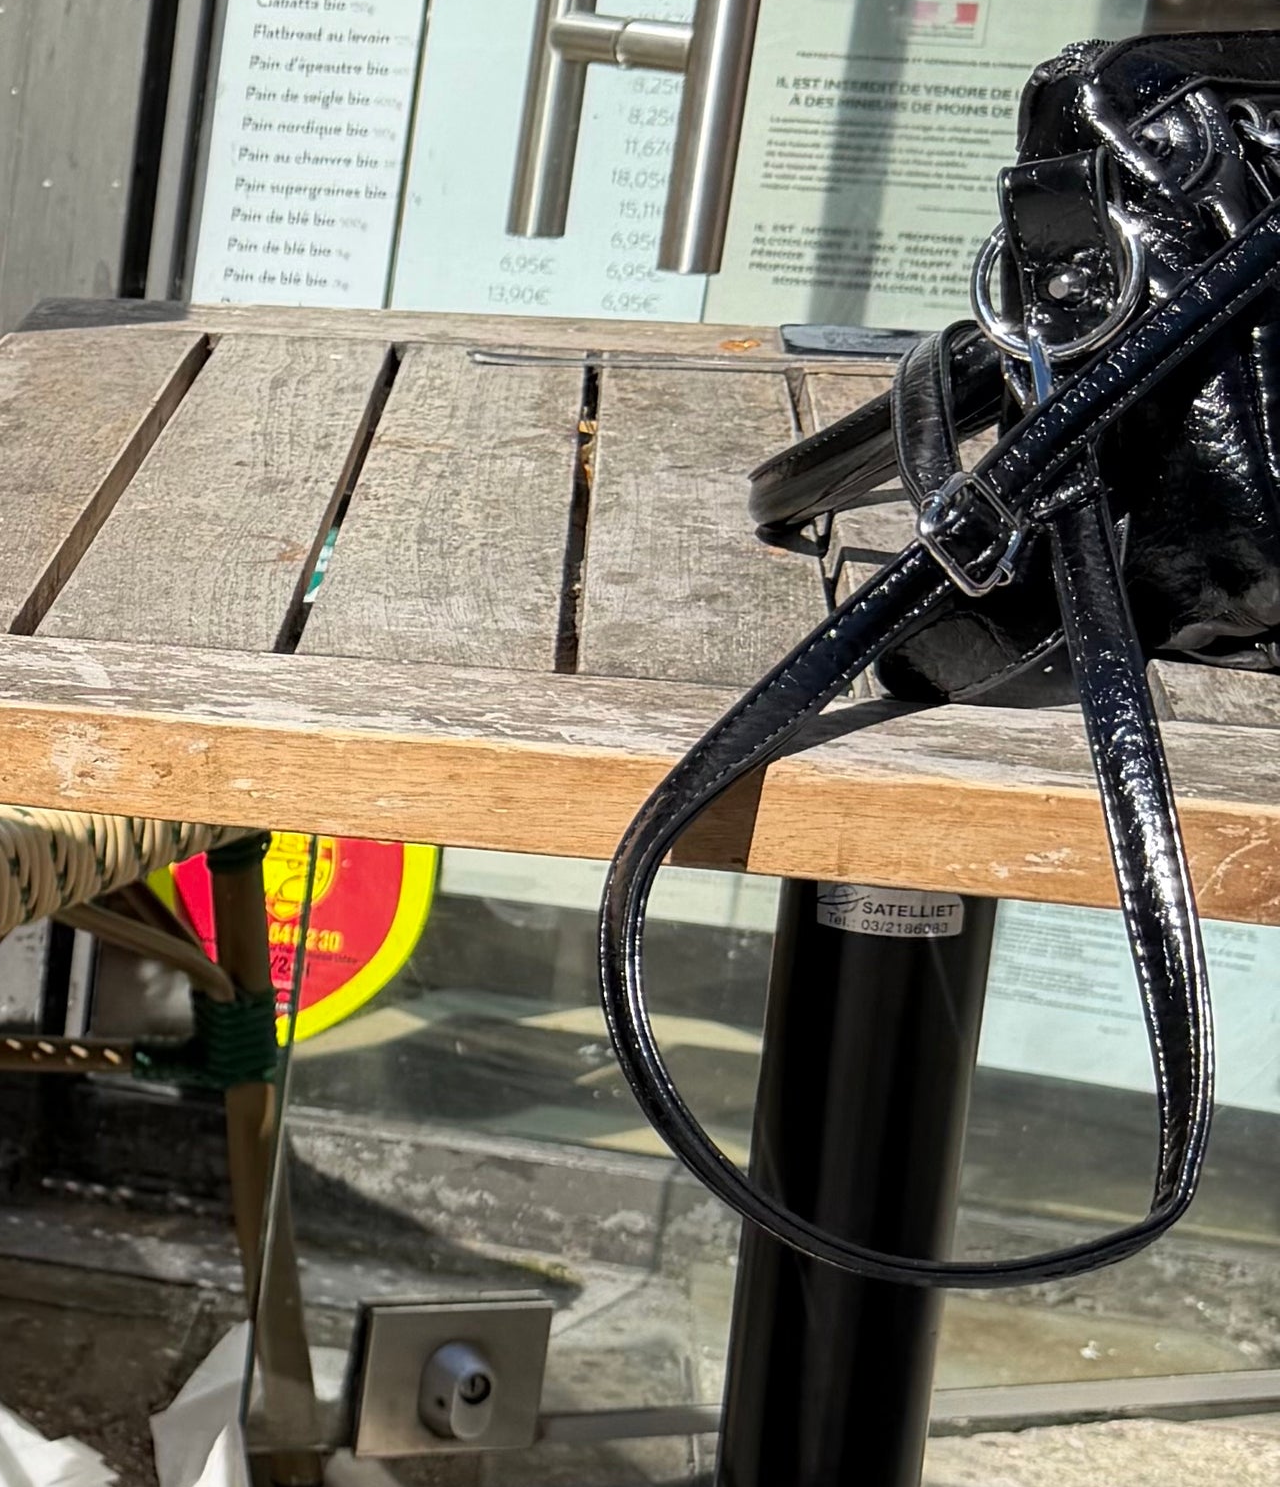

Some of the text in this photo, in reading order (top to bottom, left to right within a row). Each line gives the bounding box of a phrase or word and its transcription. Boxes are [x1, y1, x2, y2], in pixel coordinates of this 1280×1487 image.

[252, 23, 391, 45] Flatbread au levain
[249, 54, 280, 71] Pain
[367, 60, 389, 76] bio
[245, 86, 371, 110] Pain de seigle bio
[792, 77, 821, 90] EST
[823, 79, 898, 94] INTERDIT
[924, 84, 988, 99] VENDRE
[804, 95, 835, 109] DES
[935, 103, 989, 118] MOINS
[242, 116, 369, 140] Pain nordique bio
[238, 147, 269, 162] Pain
[273, 154, 290, 163] au
[356, 153, 379, 169] bio
[234, 176, 265, 192] Pain
[365, 183, 387, 199] bio
[231, 206, 336, 227] Pain de blé bio
[227, 236, 332, 257] Pain de blé bio
[499, 254, 556, 275] 6,95€
[224, 266, 328, 287] Pain de blé bio
[601, 293, 662, 313] 6,95€
[862, 901, 960, 918] SATELLIET
